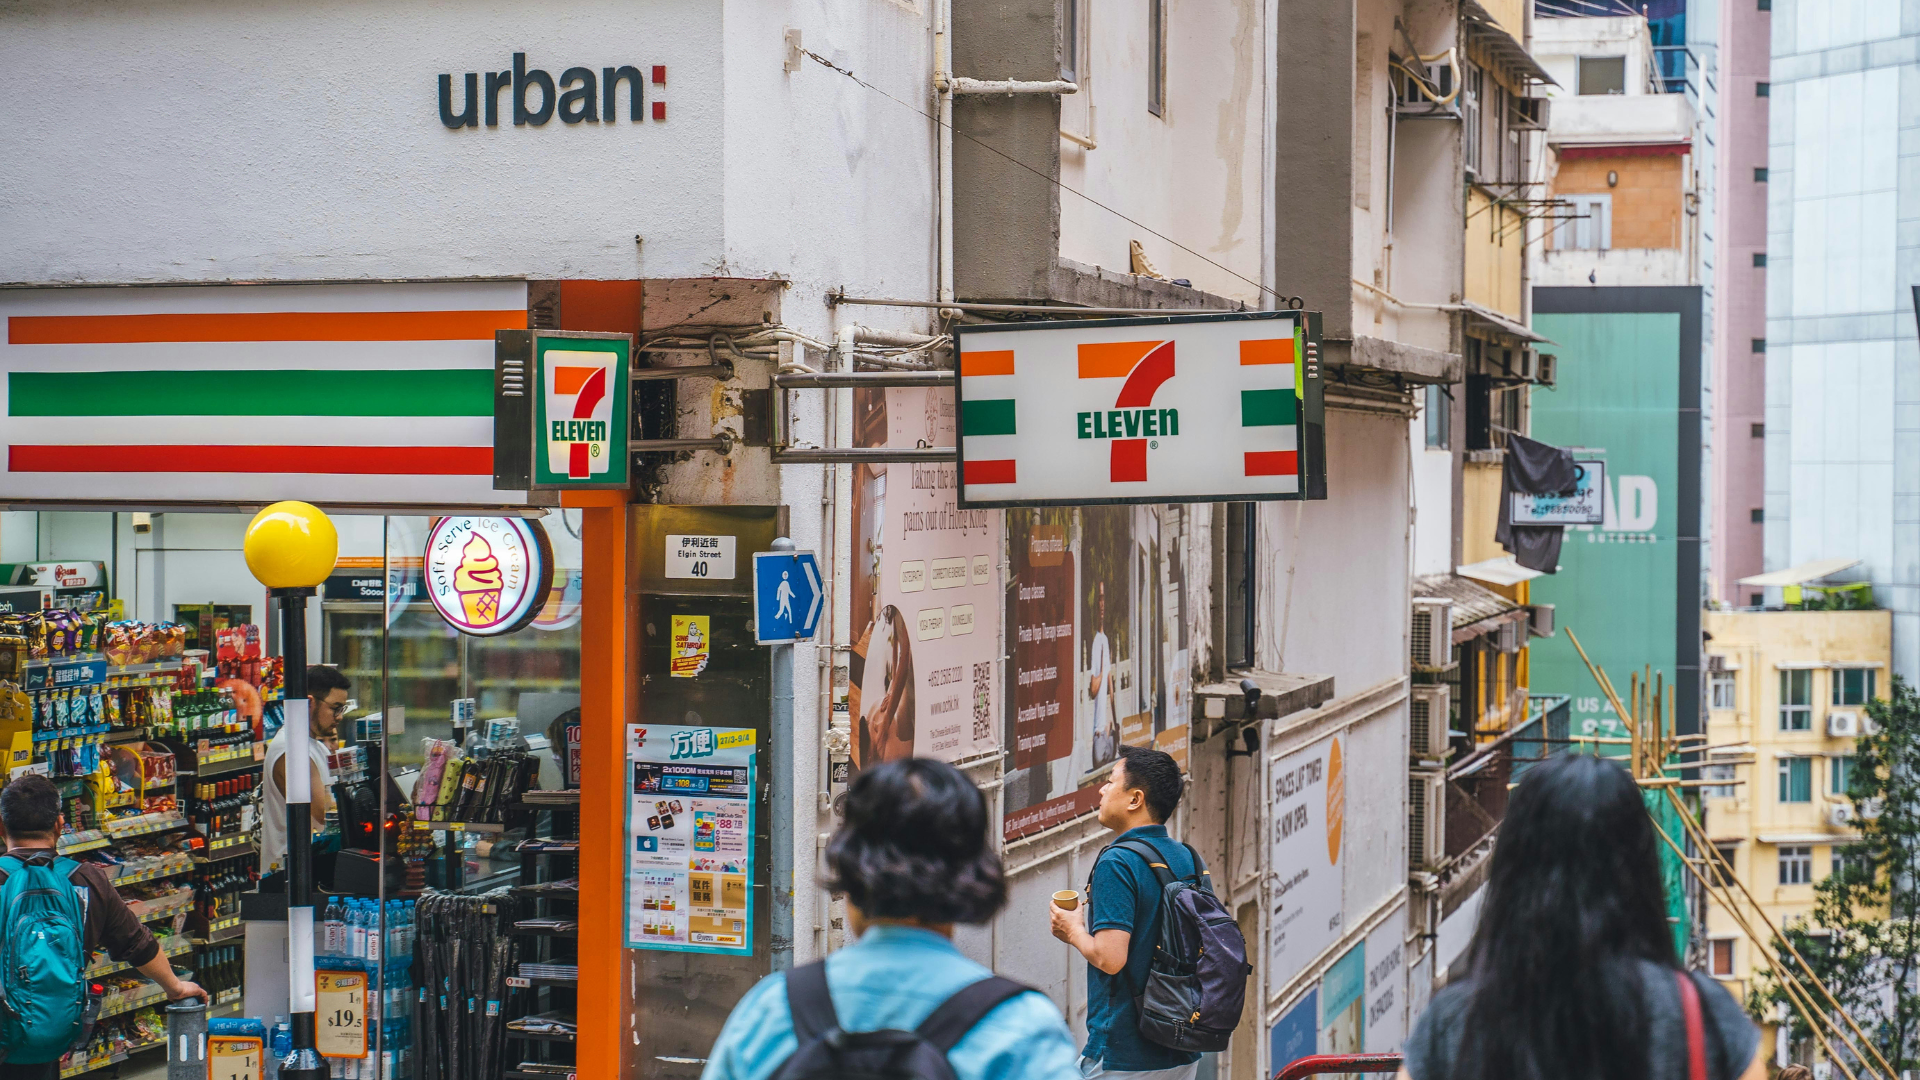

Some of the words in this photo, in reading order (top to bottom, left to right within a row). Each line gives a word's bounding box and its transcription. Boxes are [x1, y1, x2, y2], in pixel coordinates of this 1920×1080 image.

[554, 366, 606, 477] 7
[1077, 340, 1175, 482] 7
[911, 463, 935, 497] Taking
[937, 463, 948, 489] the
[478, 517, 499, 532] Ice
[903, 502, 924, 540] pains
[925, 508, 938, 531] out
[939, 502, 948, 530] of
[949, 502, 968, 537] Hong
[969, 509, 988, 536] Kong
[681, 538, 718, 548] 伊利近街
[502, 532, 520, 590] Cream
[678, 551, 697, 559] Elgin
[699, 550, 722, 558] Street
[691, 561, 708, 577] 40
[1019, 583, 1031, 603] Group
[1031, 582, 1045, 599] classes
[1019, 624, 1032, 642] Private
[1032, 623, 1042, 644] Yoga
[1042, 622, 1056, 642] Therapy
[1057, 619, 1072, 638] sessions
[1018, 667, 1030, 687] Group
[1030, 665, 1043, 687] private
[1043, 664, 1057, 681] classes
[1577, 697, 1599, 713] US
[672, 729, 711, 756] 方便
[720, 734, 750, 745] 27/3-9/4
[1017, 733, 1032, 752] Training
[1032, 732, 1046, 746] courses
[692, 879, 710, 890] 取件
[328, 1009, 362, 1028] $19.5
